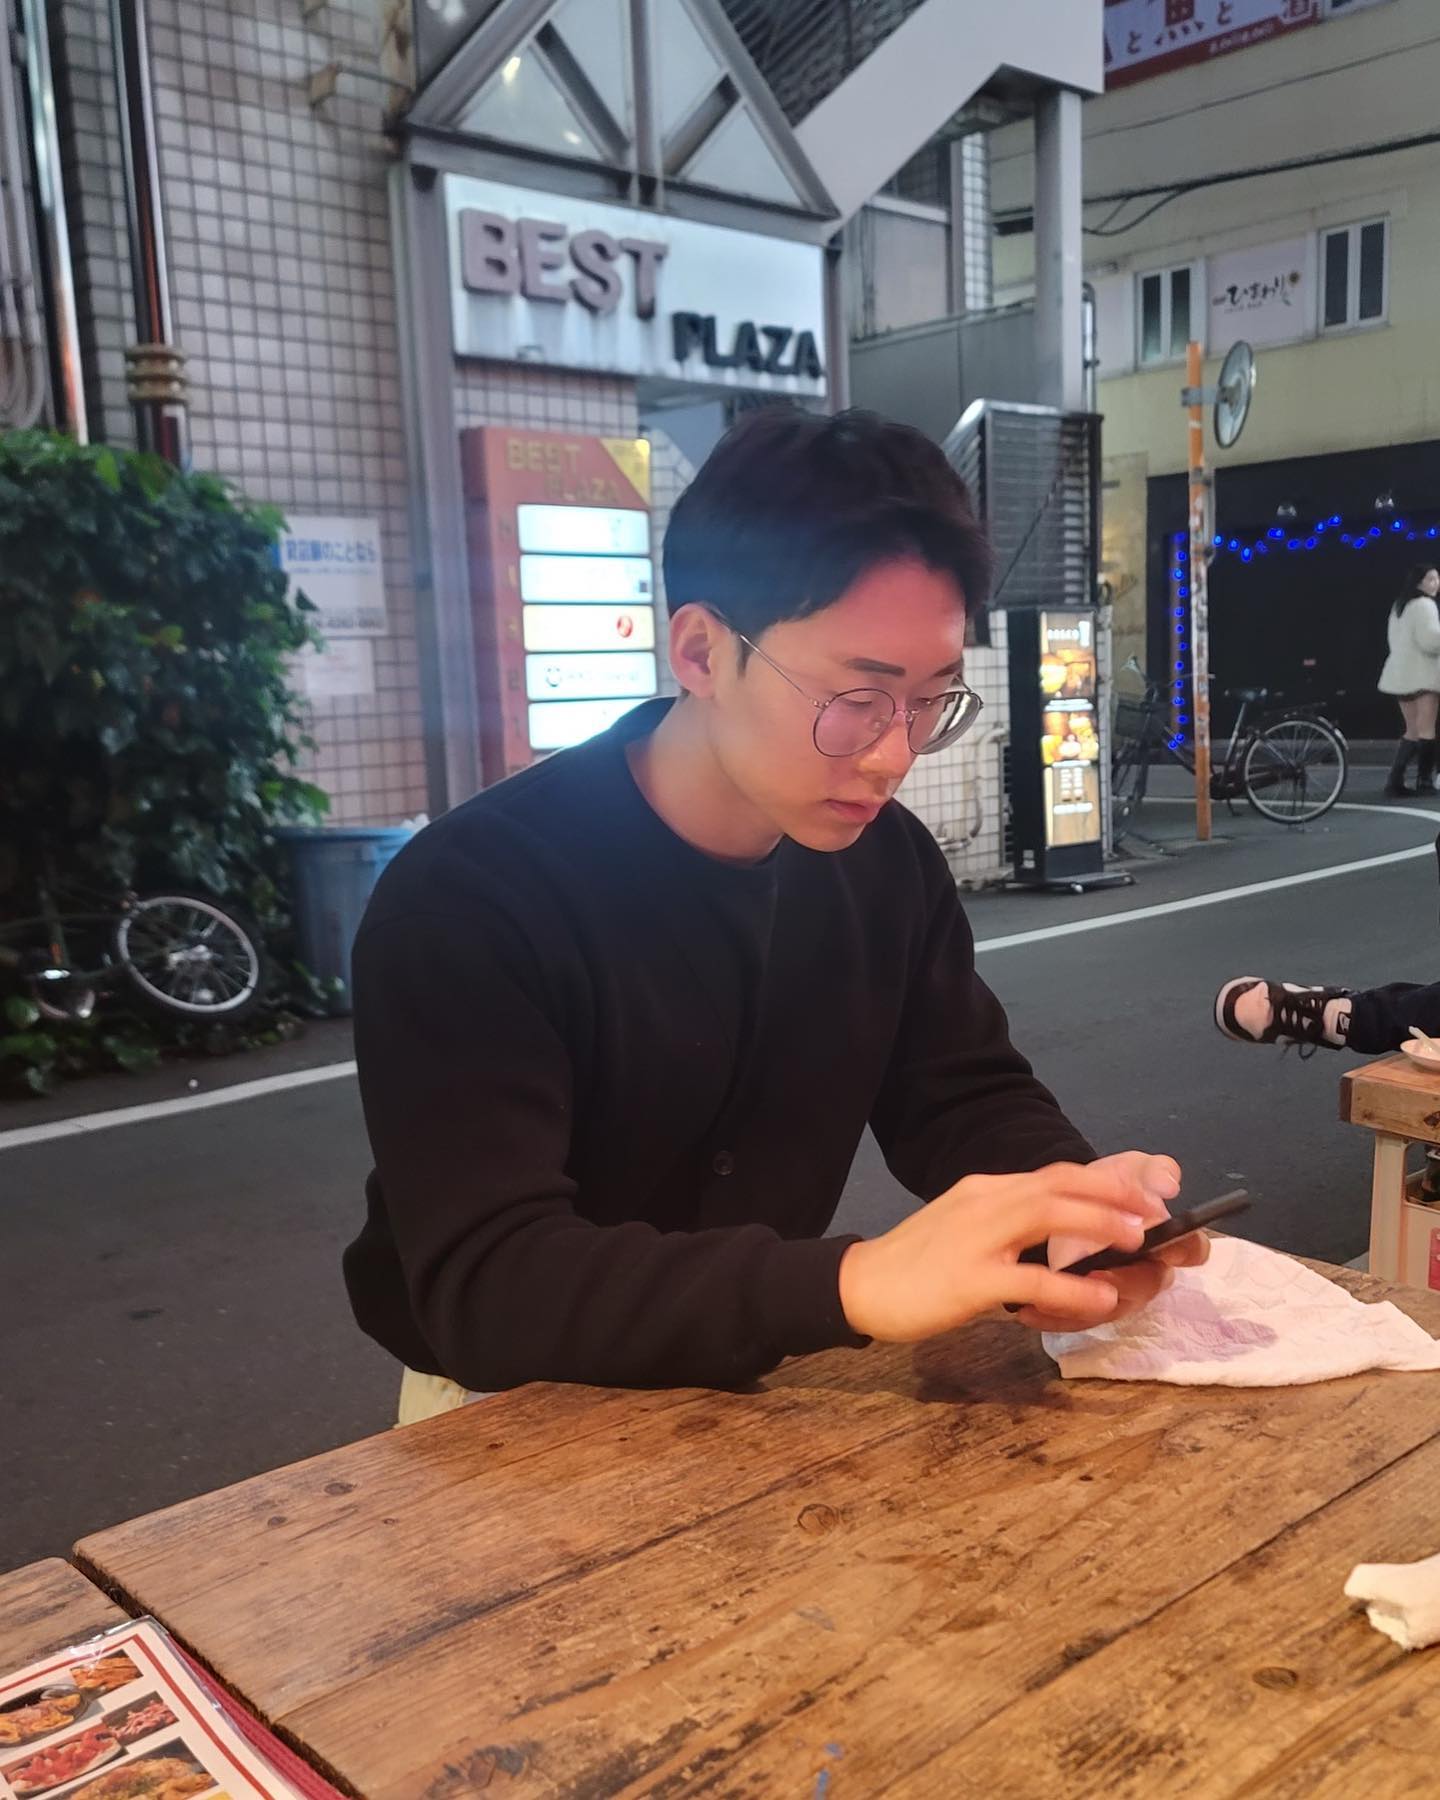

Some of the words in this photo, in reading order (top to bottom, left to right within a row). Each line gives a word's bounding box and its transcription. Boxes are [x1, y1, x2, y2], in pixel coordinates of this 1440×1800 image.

[459, 207, 669, 320] BEST
[672, 311, 824, 379] PLAZA
[507, 437, 581, 474] BEST
